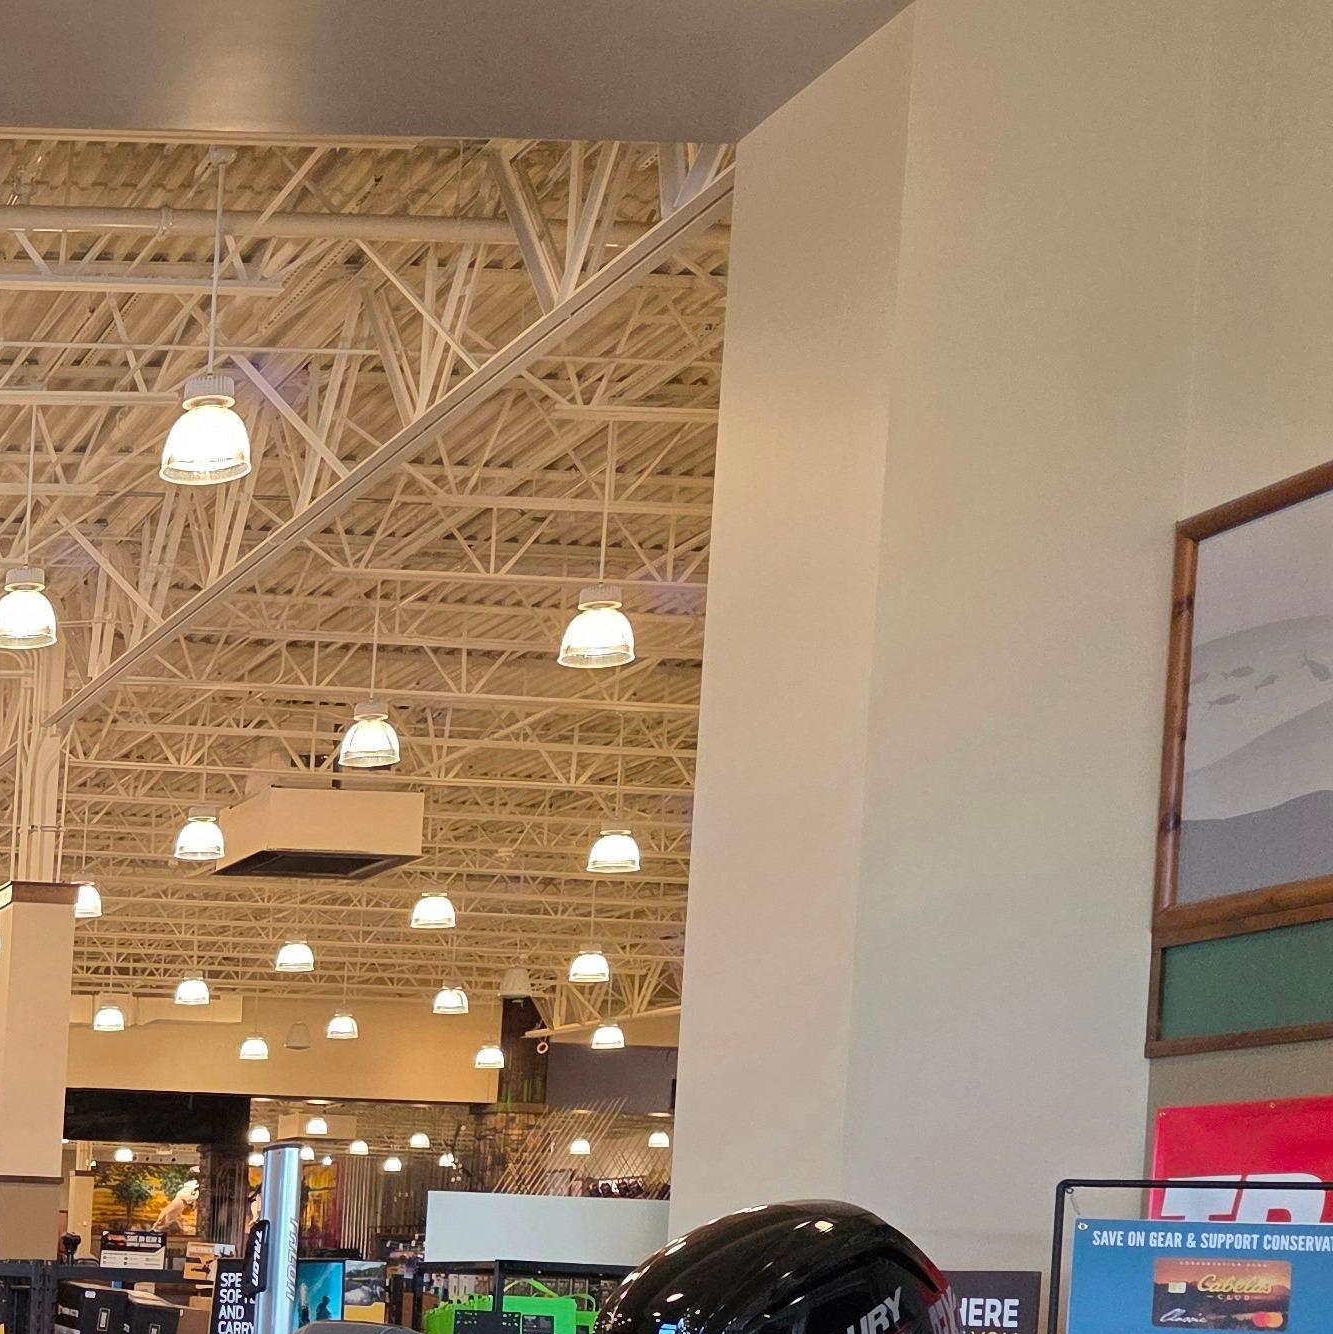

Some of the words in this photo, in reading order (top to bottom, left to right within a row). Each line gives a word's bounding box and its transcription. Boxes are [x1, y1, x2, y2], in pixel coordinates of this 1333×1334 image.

[1092, 1230, 1125, 1247] SAVE
[1127, 1231, 1145, 1247] ON
[1149, 1231, 1182, 1248] GEAR
[1186, 1232, 1197, 1249] &
[1200, 1232, 1258, 1250] SUPPORT
[251, 1230, 263, 1287] TALON
[220, 1272, 242, 1287] SPE
[219, 1289, 255, 1304] SOF
[218, 1305, 245, 1320] AND
[1160, 1308, 1208, 1323] Classic
